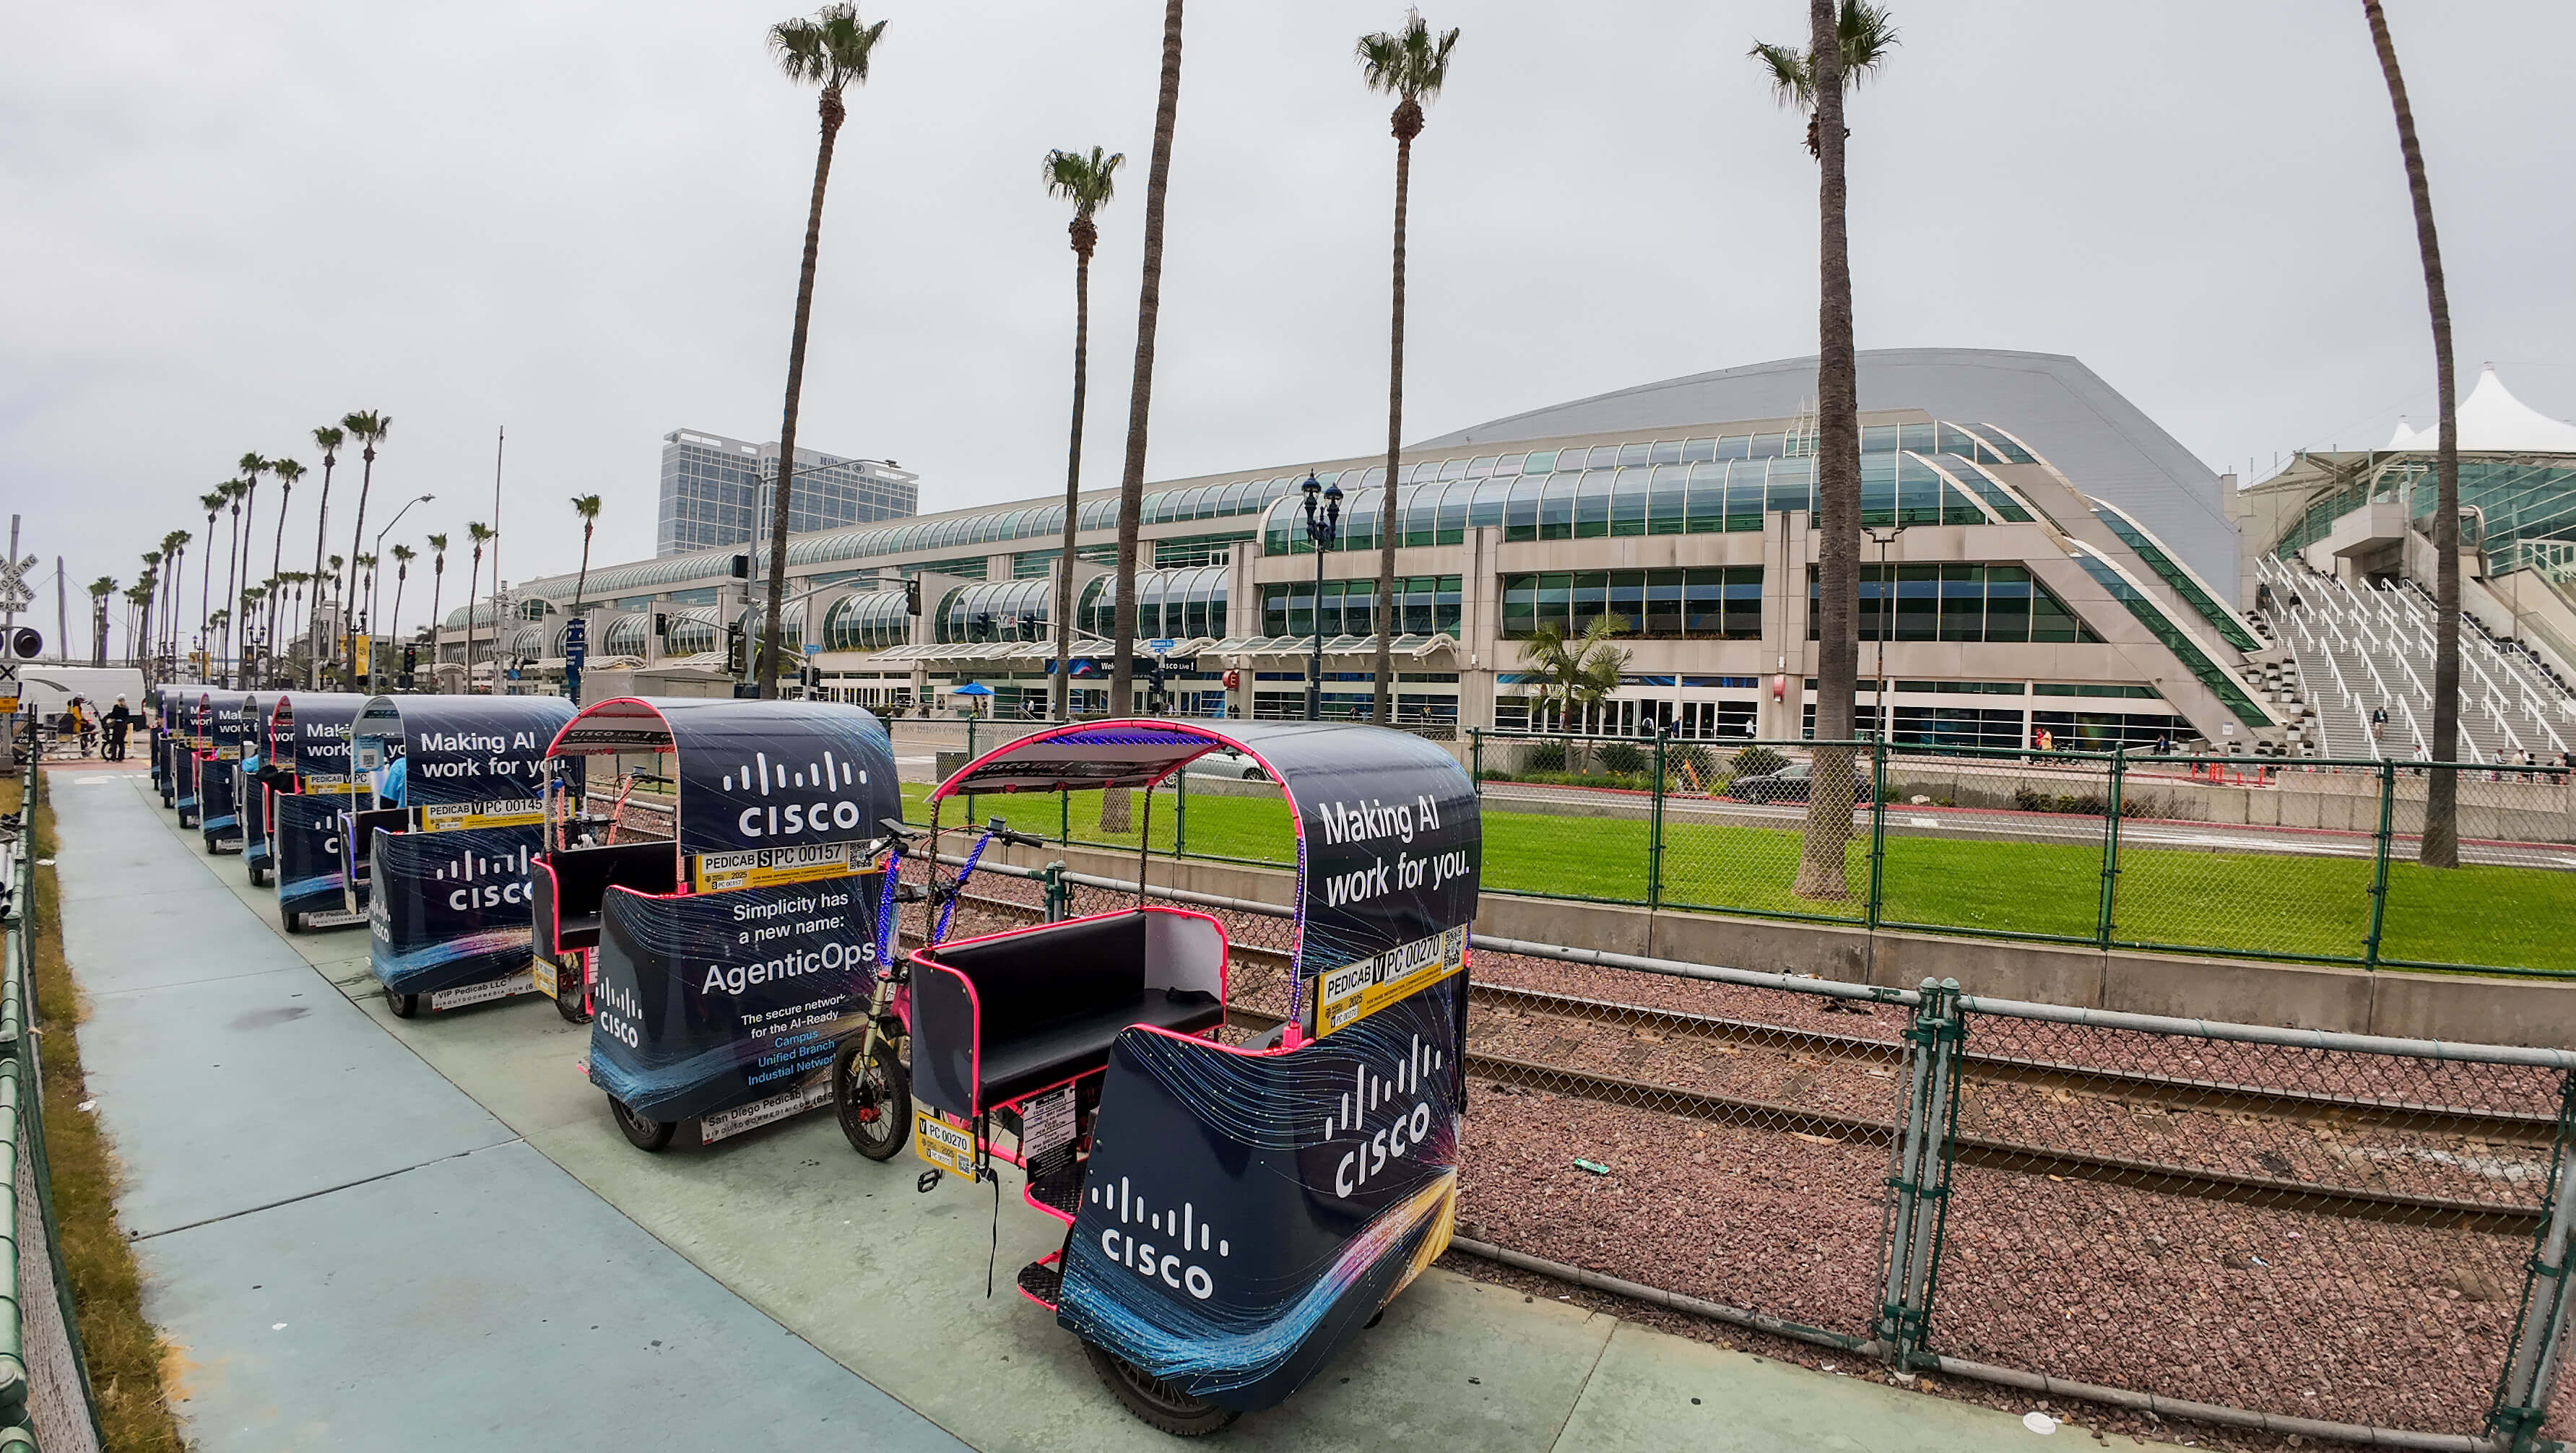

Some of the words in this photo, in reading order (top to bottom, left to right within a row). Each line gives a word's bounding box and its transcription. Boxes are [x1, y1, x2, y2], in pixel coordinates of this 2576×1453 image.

[0, 556, 36, 591] OSSING
[0, 602, 26, 612] RACKS
[9, 591, 14, 601] 3
[1231, 675, 1236, 685] E
[421, 732, 506, 754] Making
[513, 732, 535, 749] AI
[422, 758, 480, 778] work
[489, 757, 520, 776] for
[527, 760, 565, 778] you
[977, 763, 1031, 771] CISCO
[430, 804, 469, 815] PEDICAB
[473, 802, 482, 815] V
[486, 801, 502, 813] PC
[506, 799, 542, 812] 00145
[739, 801, 859, 837] CISCO
[1319, 799, 1413, 845] Making
[1418, 794, 1441, 832] AI
[706, 854, 755, 869] PEDICAB
[760, 851, 771, 867] S
[775, 847, 794, 864] PC
[799, 843, 843, 862] 00157
[732, 871, 747, 880] 2025
[1327, 856, 1390, 908] work
[1397, 851, 1428, 891] for
[1433, 849, 1470, 891] you.
[733, 896, 817, 921] Simplicity
[820, 891, 849, 908] has
[372, 921, 390, 943] CISCO
[739, 932, 750, 945] a
[755, 925, 792, 942] new
[796, 916, 845, 937] name:
[702, 942, 877, 996] AgenticOps
[1327, 966, 1371, 999] PEDICAB
[1375, 955, 1384, 983] V
[1387, 948, 1403, 977] PC
[1405, 934, 1440, 968] 00270
[438, 990, 452, 999] VIP
[455, 984, 488, 996] Pedicab
[490, 980, 507, 989] LLC
[1349, 993, 1363, 1009] 2025
[741, 1014, 763, 1025] The
[766, 1005, 802, 1020] secure
[751, 1028, 768, 1039] for
[770, 1023, 787, 1034] the
[790, 1010, 838, 1030] AI-Ready
[600, 1010, 638, 1049] CISCO
[774, 1030, 819, 1049] Campus
[758, 1049, 797, 1067] Unified
[799, 1039, 836, 1057] Branch
[748, 1065, 794, 1086] Industial
[708, 1114, 728, 1127] San
[731, 1104, 760, 1120] Diego
[763, 1091, 802, 1110] Pedicab
[813, 1090, 833, 1106] (619
[919, 1119, 926, 1134] V
[930, 1124, 940, 1139] PC
[942, 1129, 967, 1150] 00270
[1335, 1103, 1429, 1198] CISCO
[1101, 1228, 1214, 1299] CISCO
